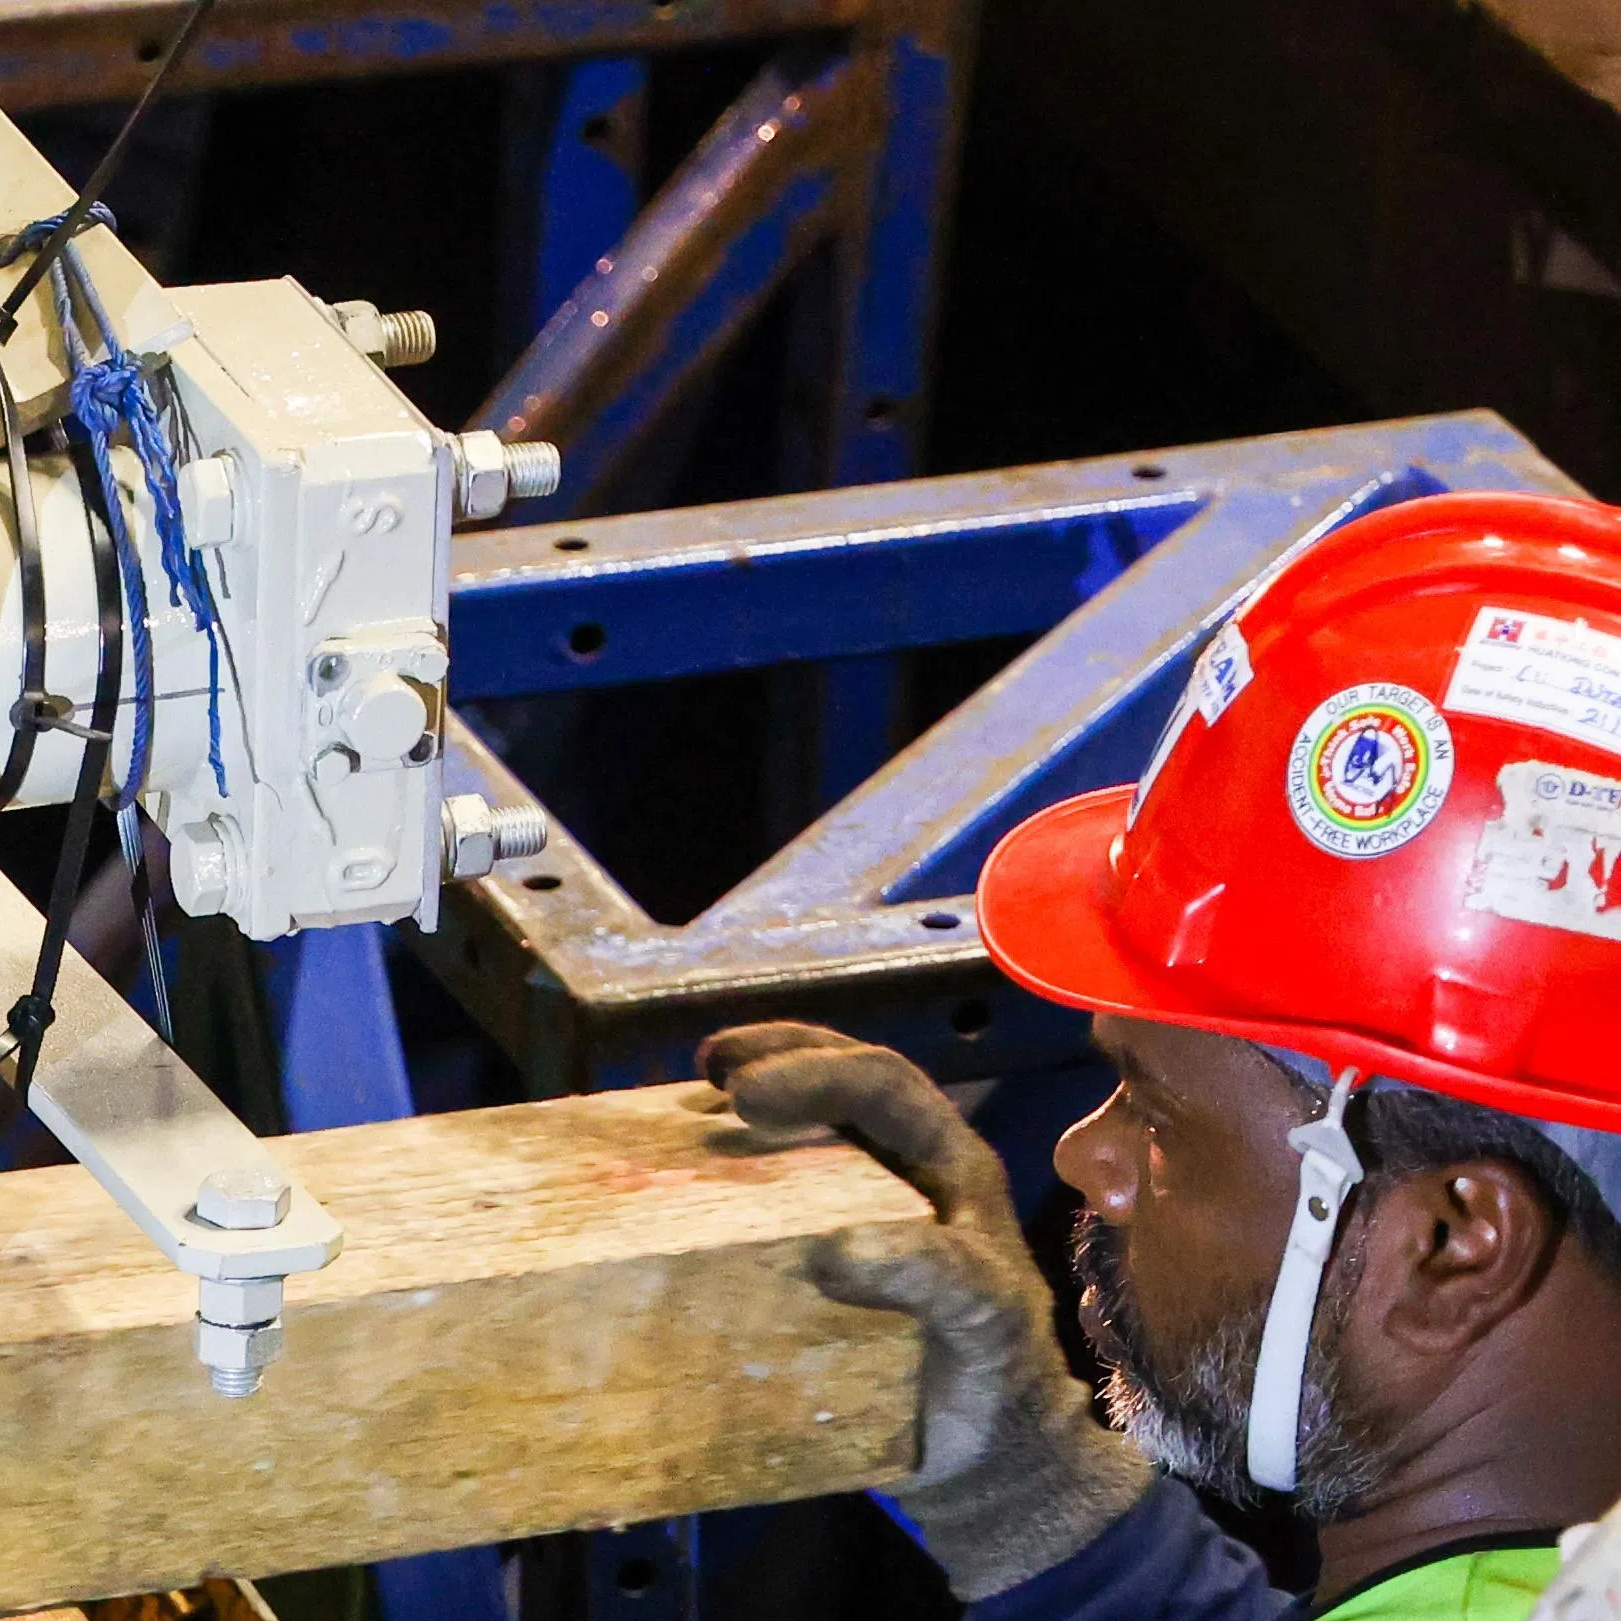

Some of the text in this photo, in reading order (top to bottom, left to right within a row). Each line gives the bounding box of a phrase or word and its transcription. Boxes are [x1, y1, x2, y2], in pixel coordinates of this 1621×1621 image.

[1326, 689, 1359, 716] OUR
[1369, 685, 1430, 715] TARGET
[1434, 739, 1450, 761] AN
[1355, 785, 1444, 850] WORKPLACE
[1568, 780, 1621, 804] D-TE
